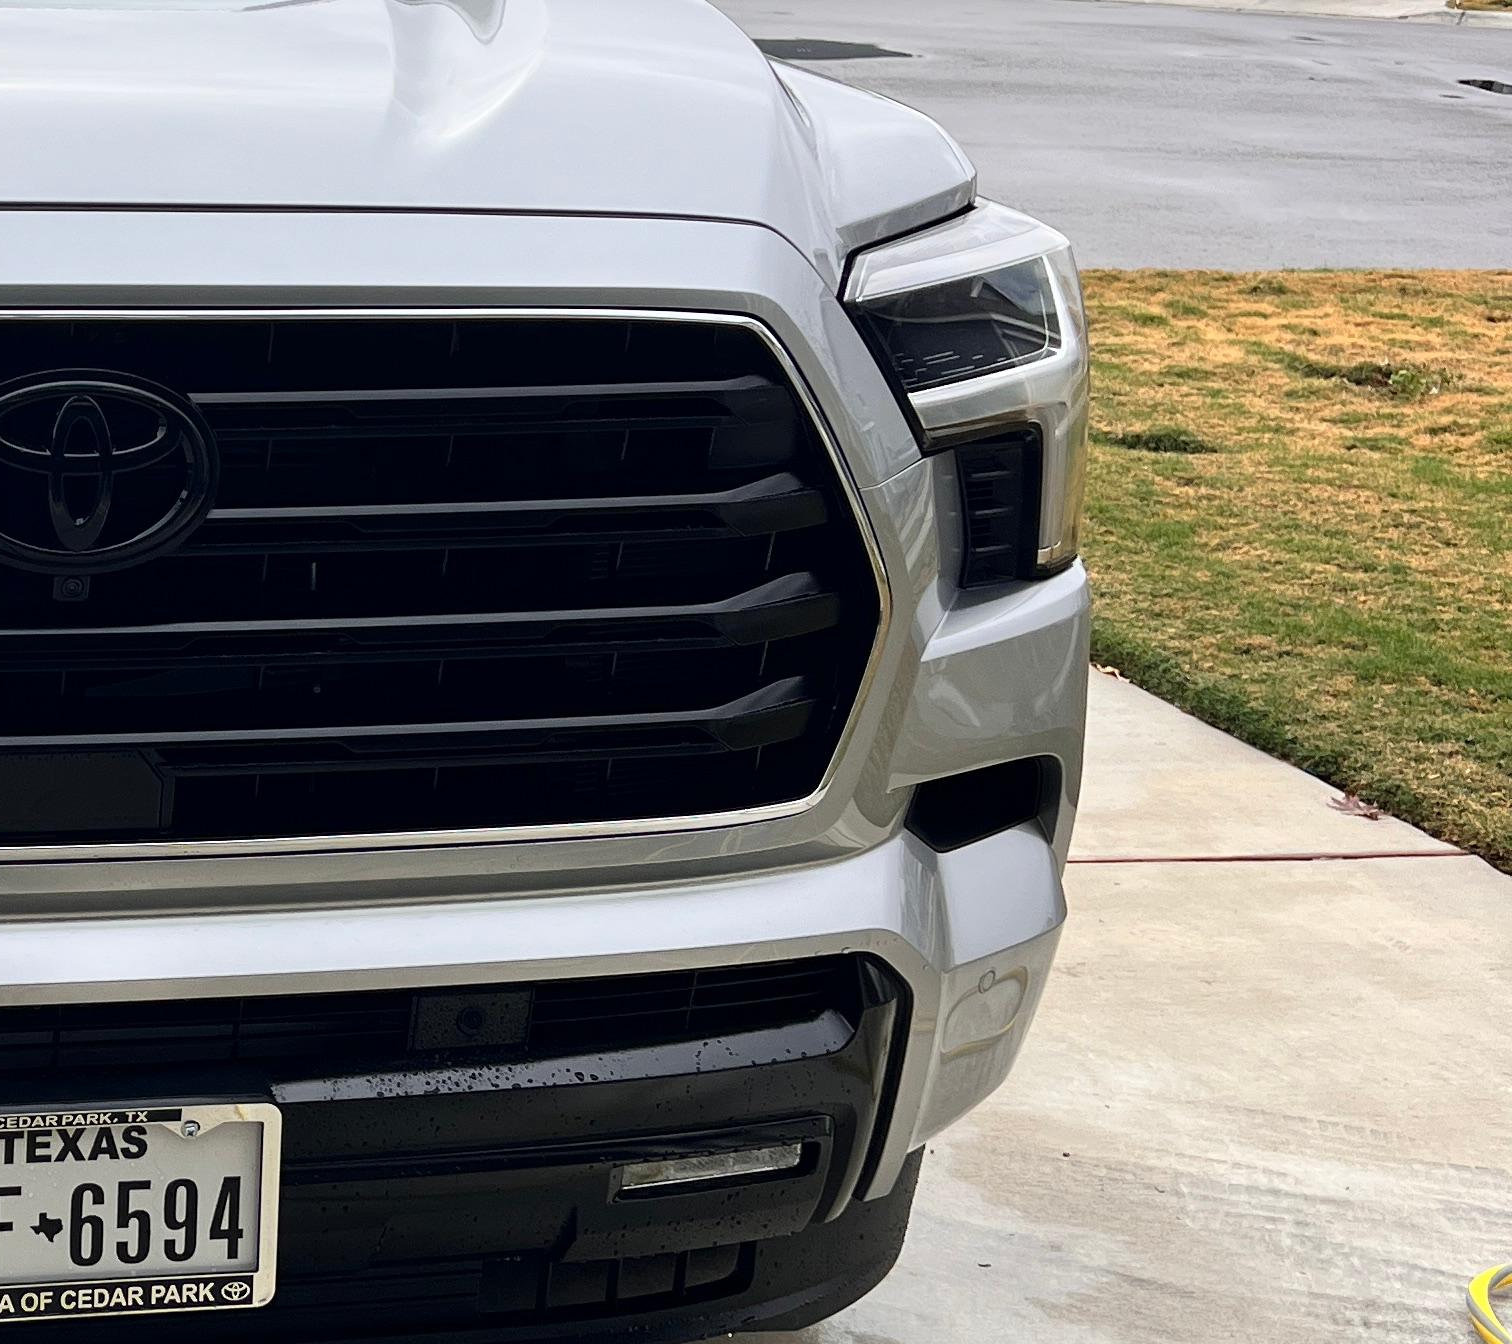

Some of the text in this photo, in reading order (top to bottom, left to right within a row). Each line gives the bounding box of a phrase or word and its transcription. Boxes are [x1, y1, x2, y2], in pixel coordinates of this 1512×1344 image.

[61, 1112, 119, 1126] PARK,
[125, 1110, 149, 1123] TX
[69, 1176, 244, 1267] 6594
[21, 1291, 54, 1312] OF
[60, 1286, 144, 1310] CEDAR
[151, 1282, 215, 1305] PARK
